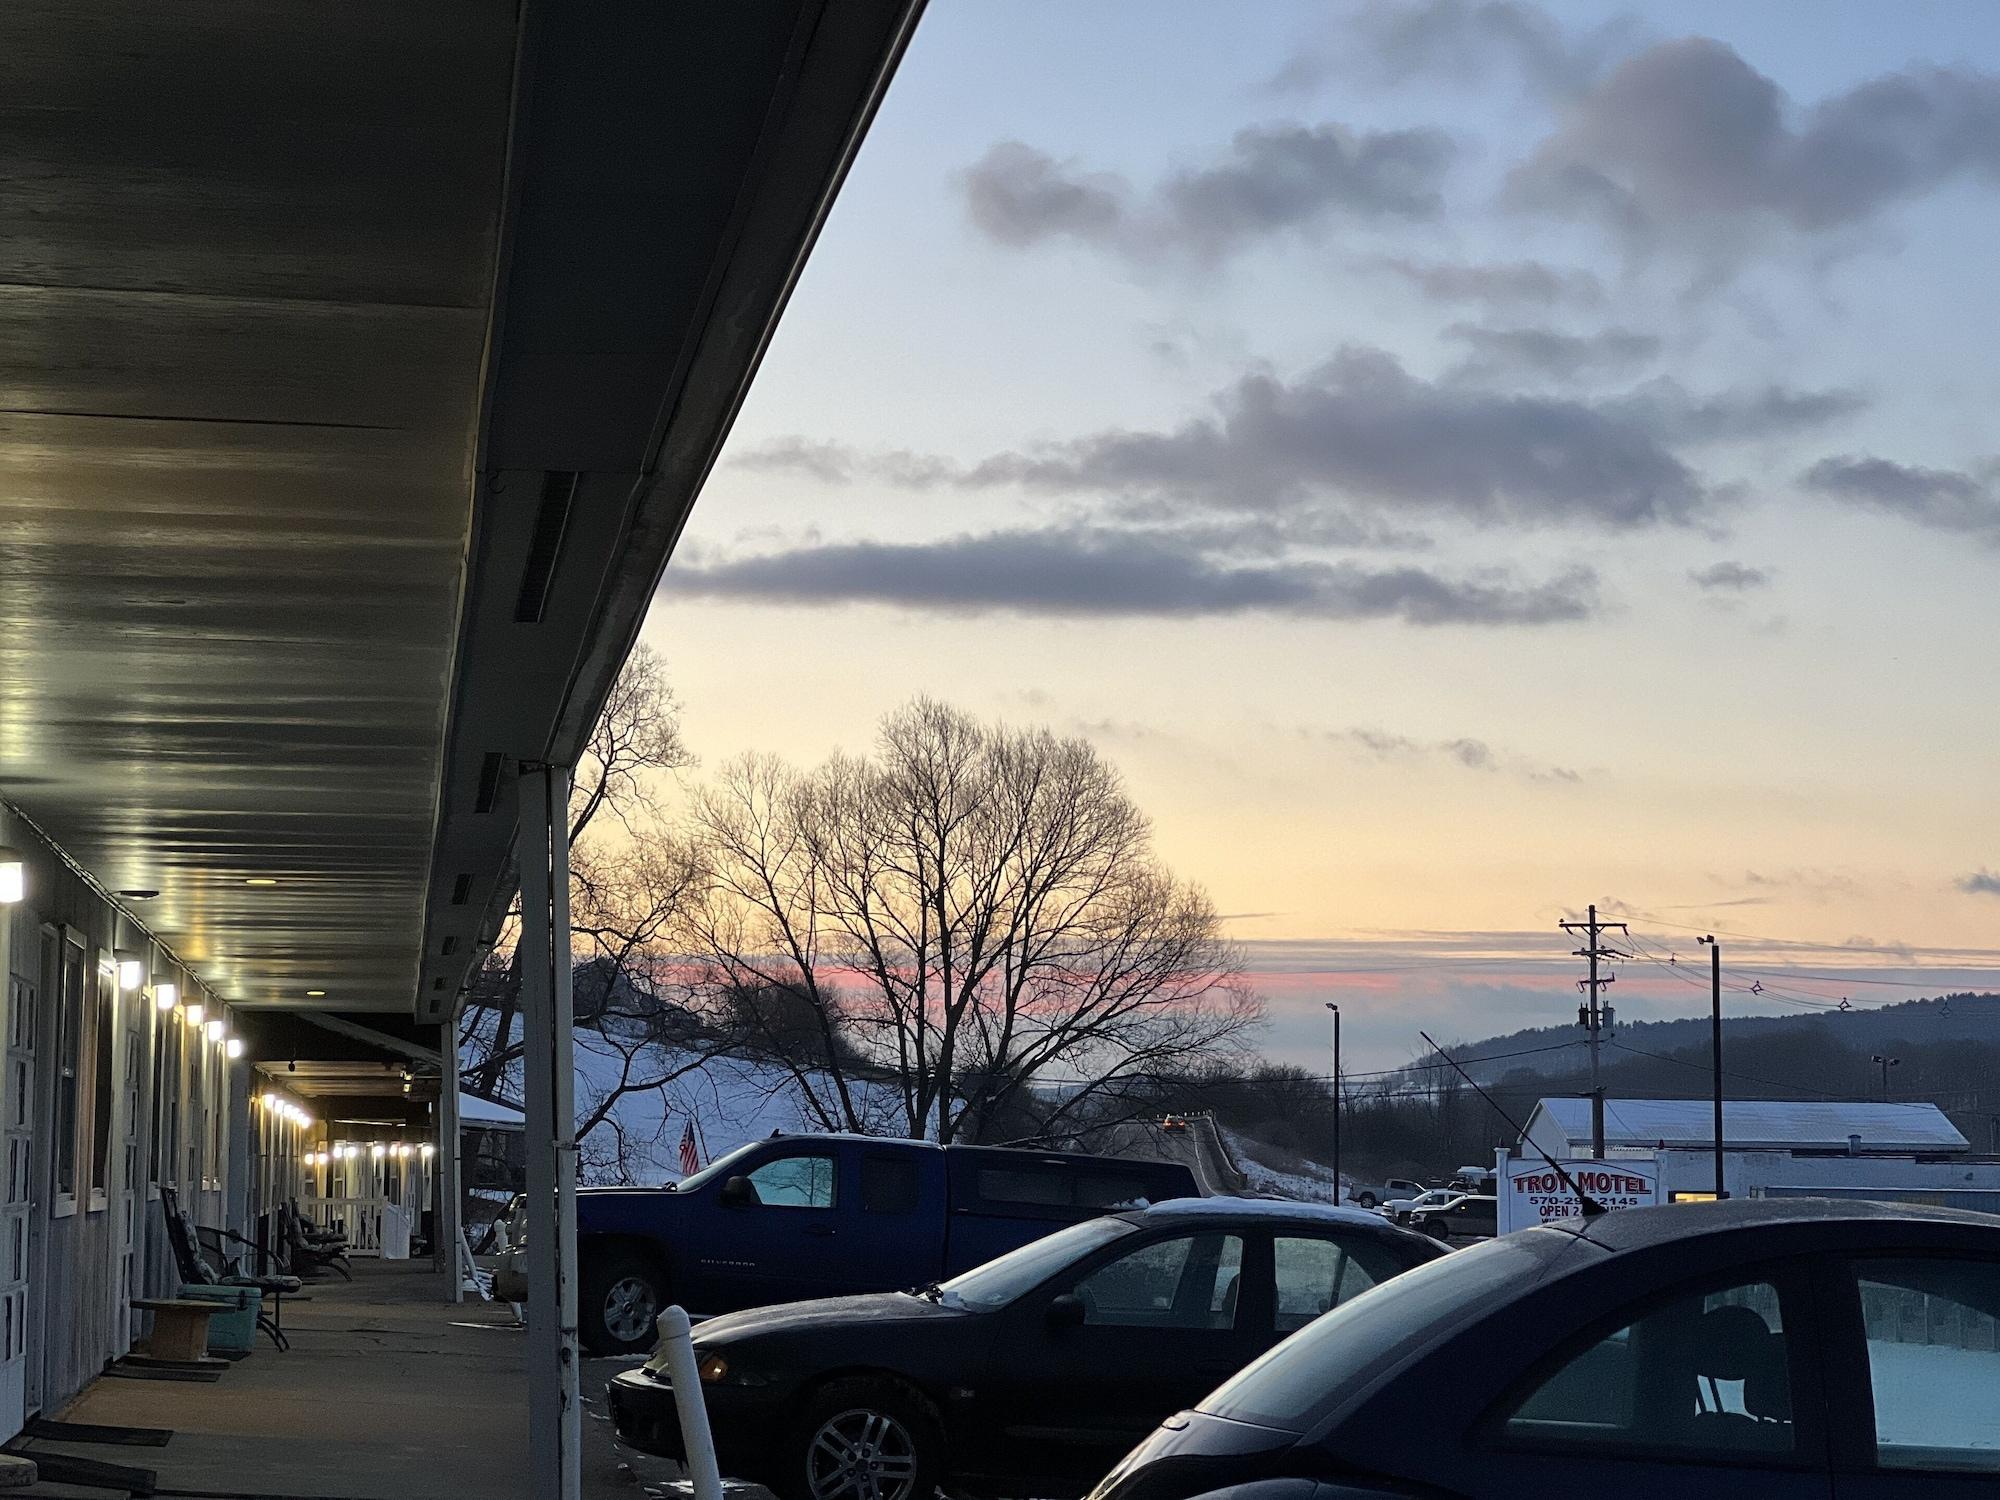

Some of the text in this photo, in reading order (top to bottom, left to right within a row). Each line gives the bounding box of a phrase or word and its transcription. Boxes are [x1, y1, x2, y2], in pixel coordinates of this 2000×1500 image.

[1513, 1171, 1652, 1195] TROY MOTEL
[1529, 1196, 1638, 1206] 570-29-2145
[1539, 1206, 1569, 1217] OPEN
